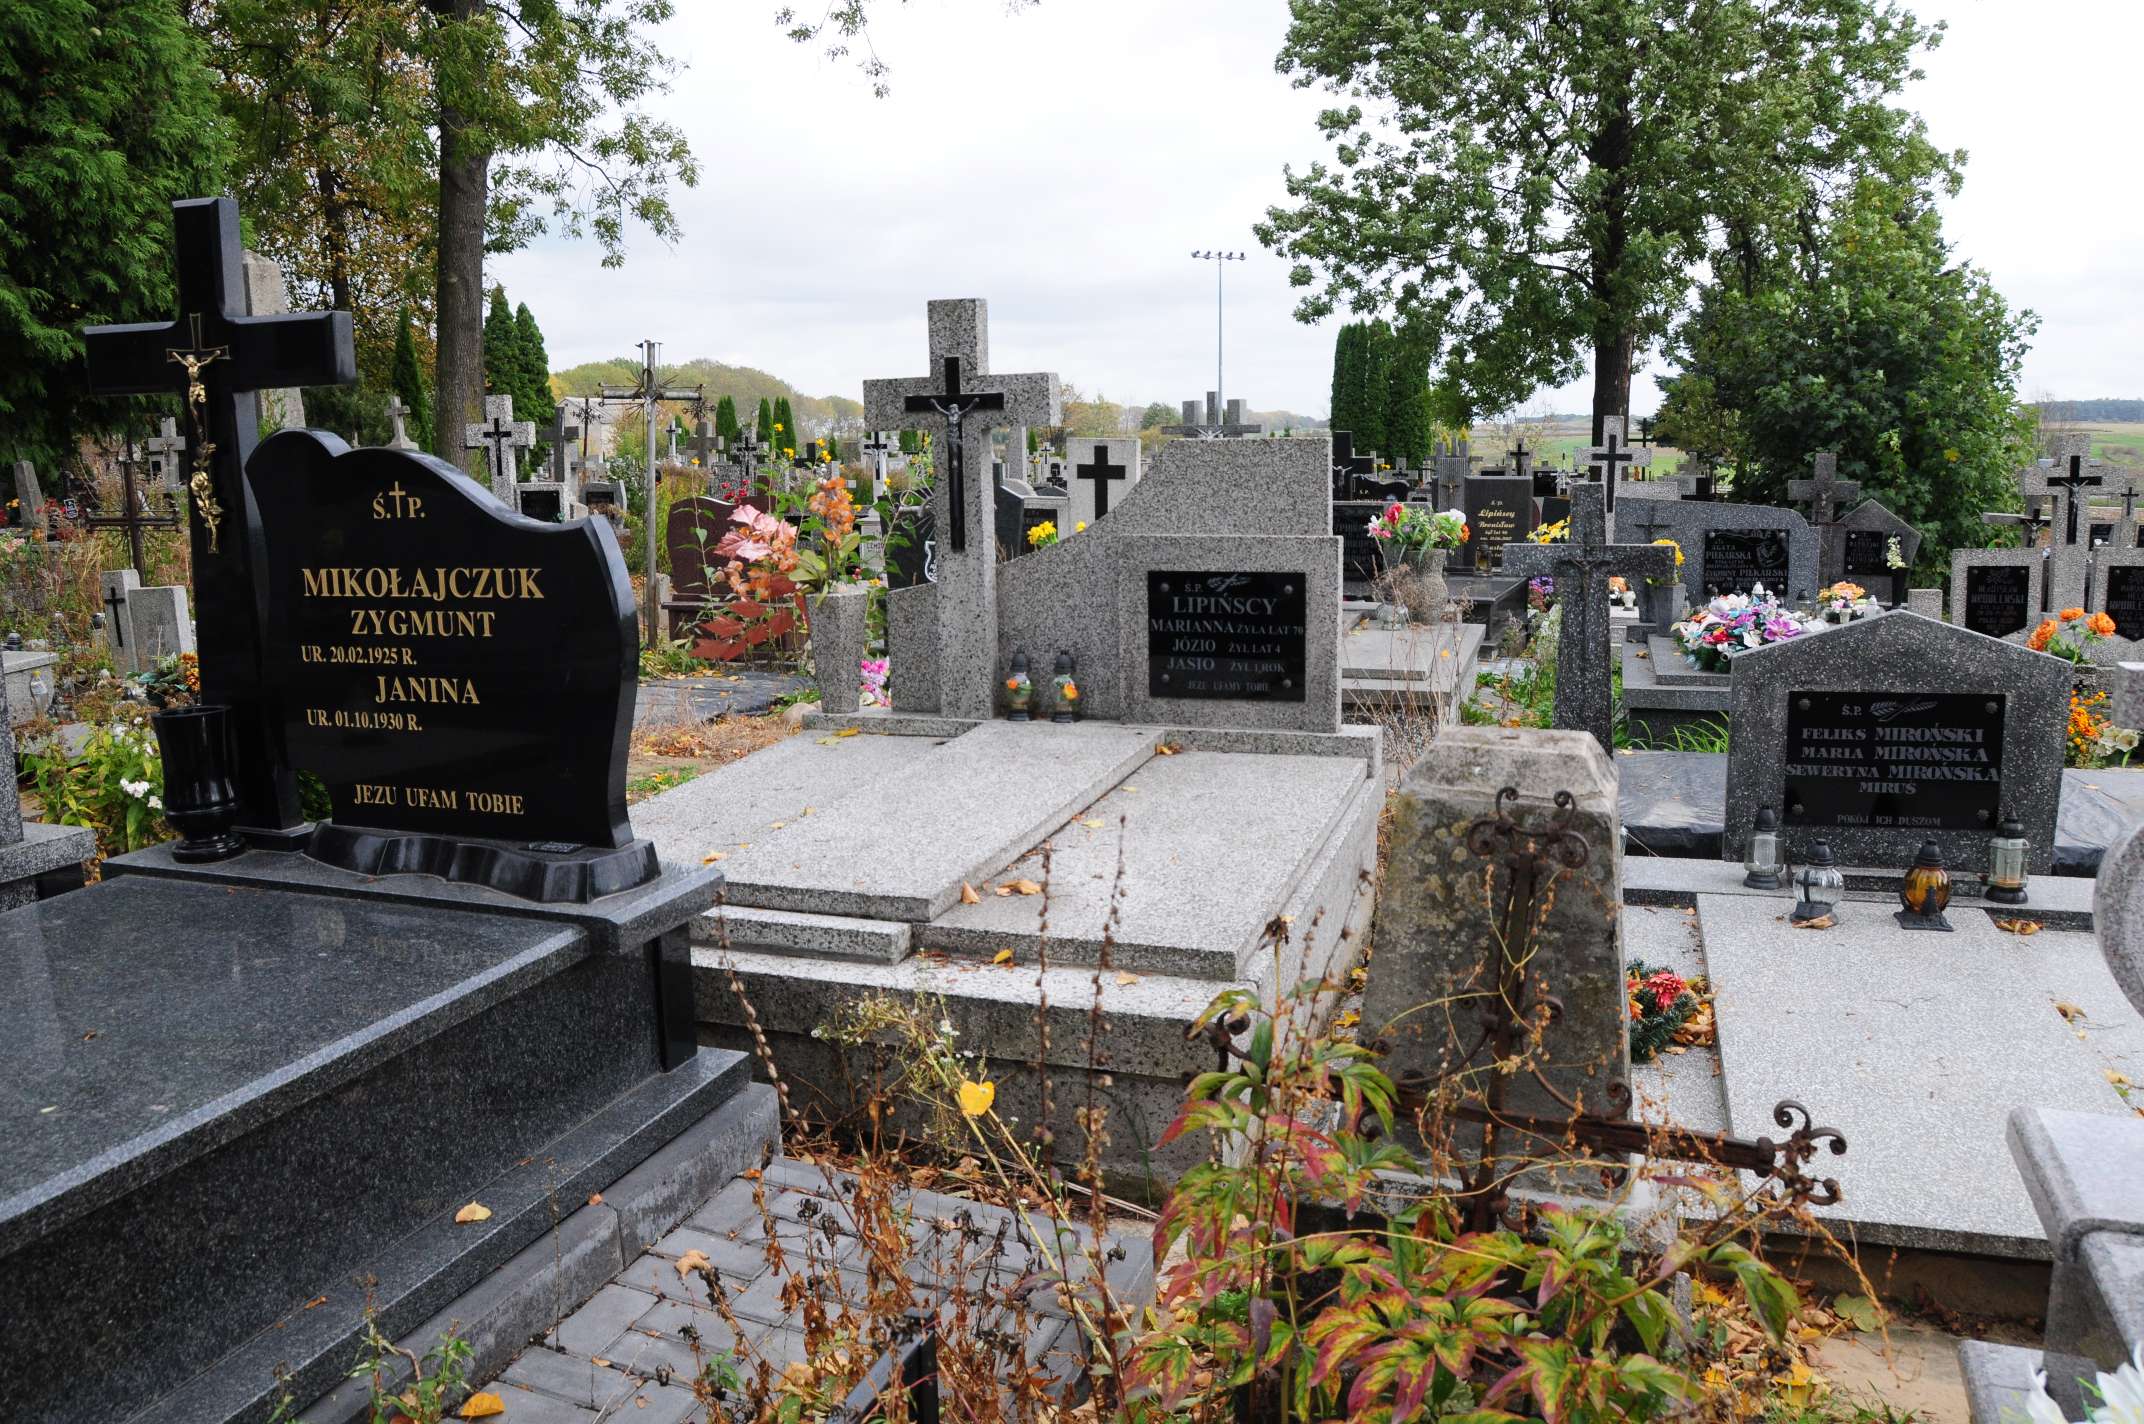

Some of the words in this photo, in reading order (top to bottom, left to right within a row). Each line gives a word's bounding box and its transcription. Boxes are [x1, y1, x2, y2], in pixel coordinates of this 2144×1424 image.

[302, 567, 545, 601] MIKOŁAJCZUK
[1173, 592, 1277, 615] LIPIŃSCY
[351, 610, 495, 637] ZYGMUNT
[1151, 619, 1234, 633] MARIANNA
[301, 645, 327, 663] UR.
[330, 646, 398, 665] 20.02.1925
[402, 648, 417, 665] R.
[1172, 636, 1216, 653] JÓZIO
[376, 676, 480, 704] JANINA
[307, 709, 332, 727] UR.
[335, 710, 403, 731] 01.10.1930
[407, 713, 423, 731] R.
[1802, 728, 1867, 741] FELIKS
[1875, 722, 1985, 743] MIROŃSKI
[1801, 746, 1864, 759] MARIA
[1874, 743, 1989, 762] MIROŃSKA
[1785, 763, 1880, 778] SEWERYNA
[1888, 761, 1999, 781] MIROŃSKA
[354, 784, 397, 806] JEZU
[405, 787, 457, 809] UFAM
[466, 792, 524, 815] TOBIE
[1837, 813, 1869, 825] POKÓJ
[1876, 815, 1893, 825] ICH
[1899, 816, 1941, 827] DUSZOM
